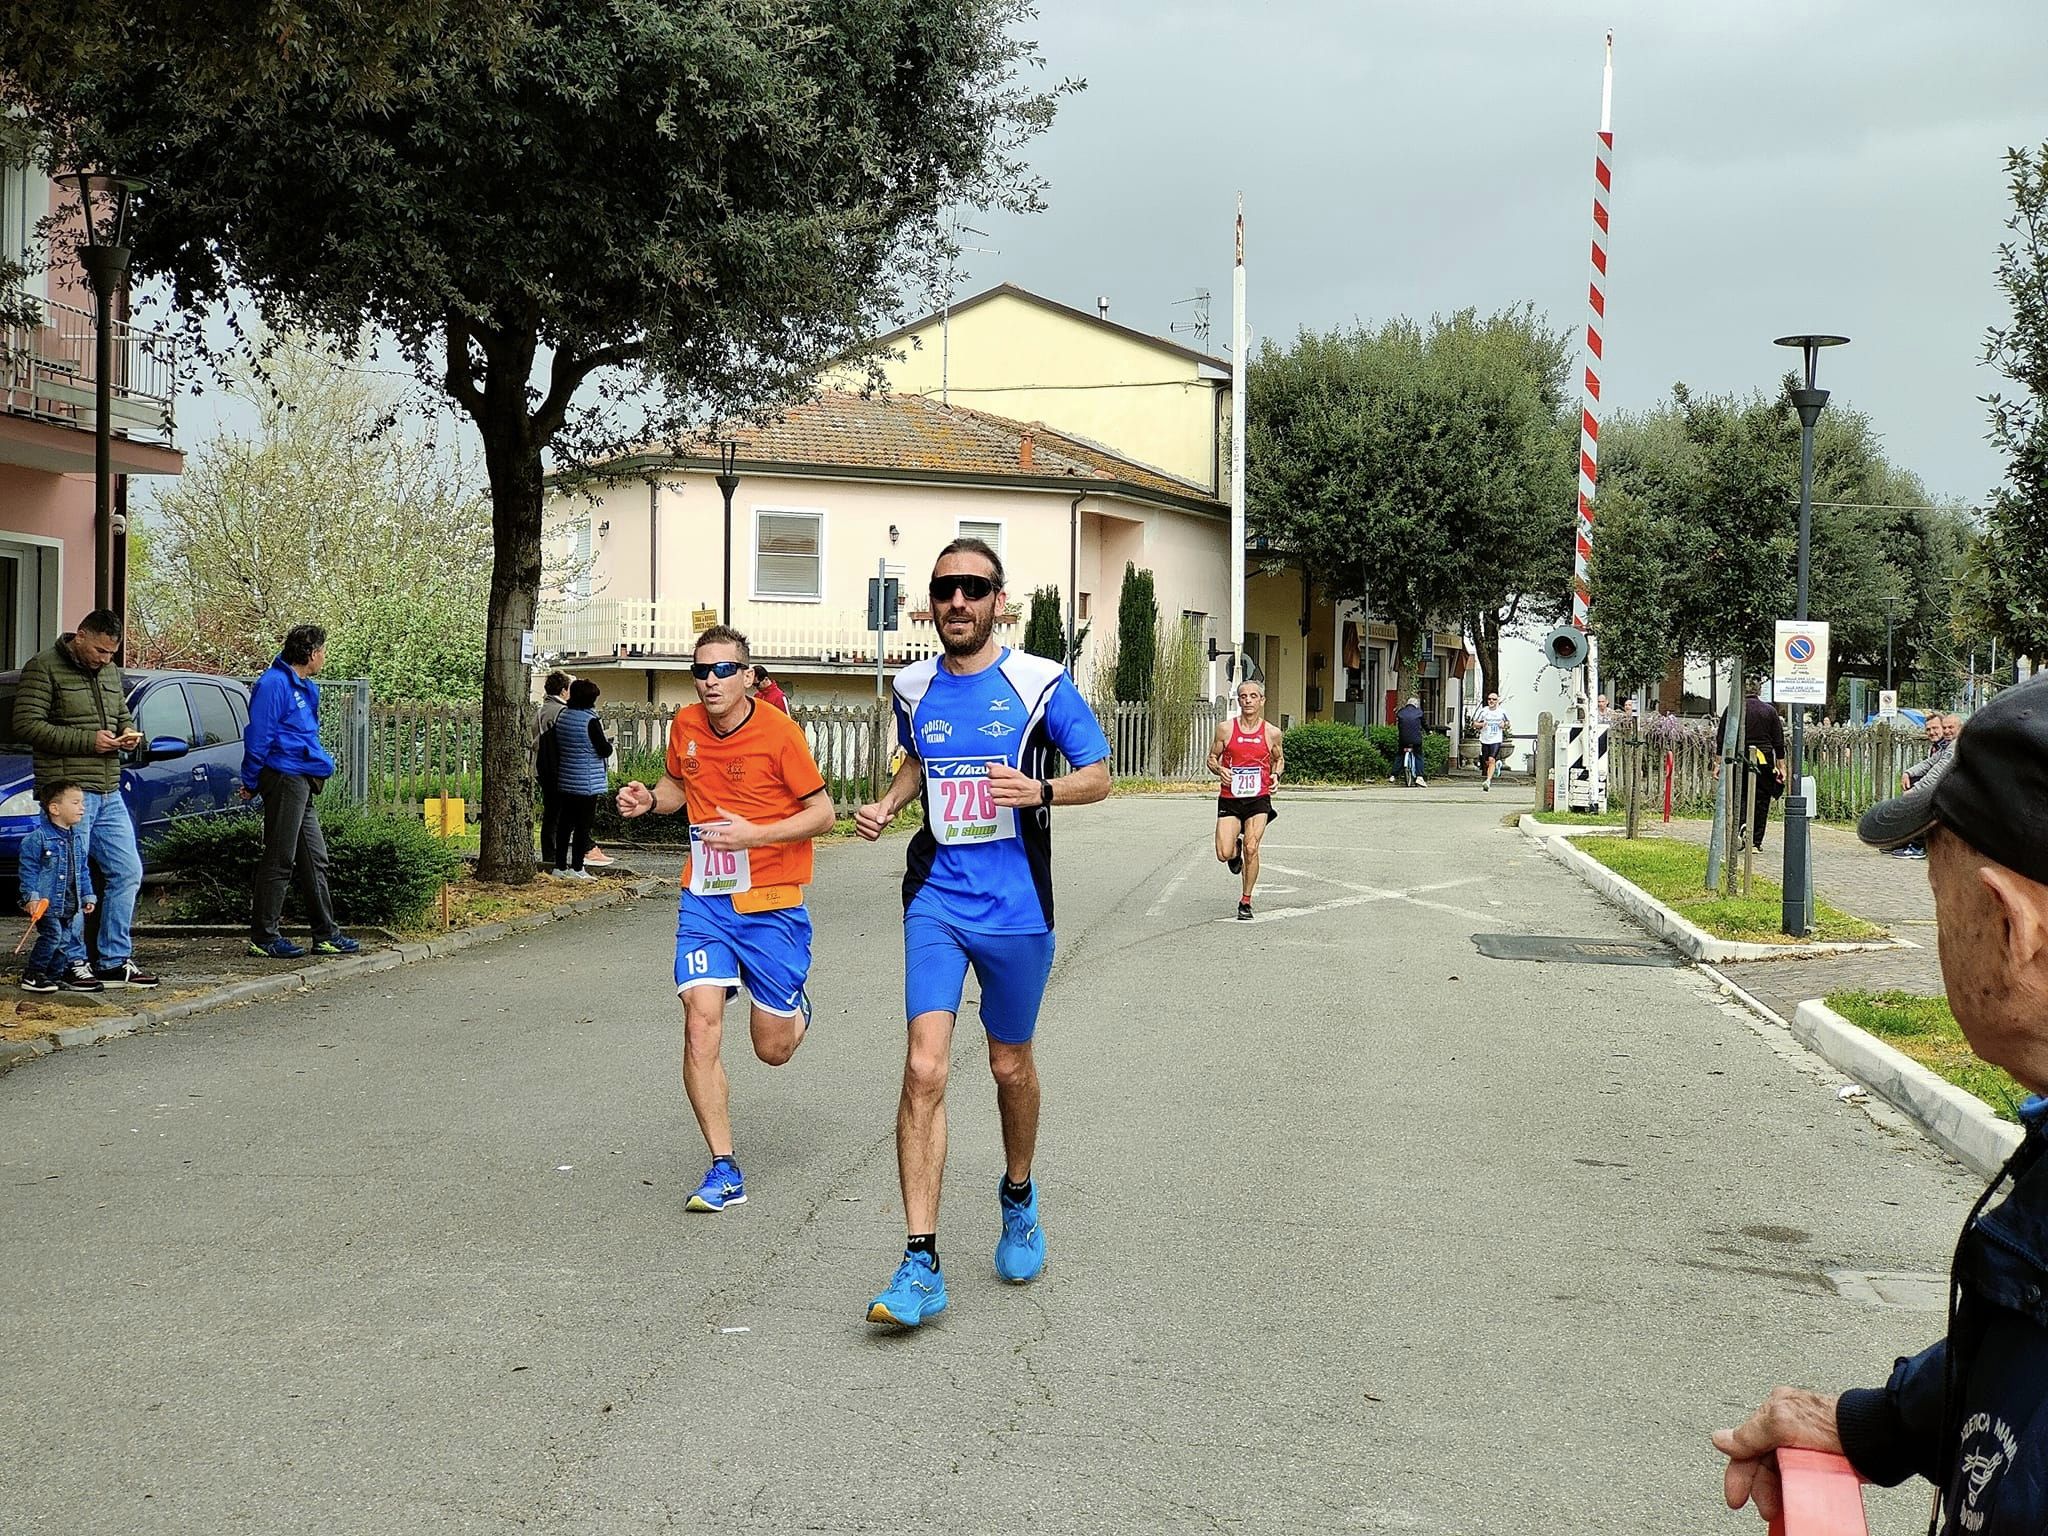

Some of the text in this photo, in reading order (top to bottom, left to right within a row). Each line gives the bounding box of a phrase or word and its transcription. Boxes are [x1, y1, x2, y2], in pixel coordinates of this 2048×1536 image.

[1362, 624, 1396, 639] TBACCHERIA
[920, 719, 953, 739] PODISTICA
[953, 764, 990, 776] MIZU
[1238, 774, 1255, 789] 213
[940, 779, 997, 822] 226
[702, 842, 736, 876] 216
[684, 949, 709, 976] 19
